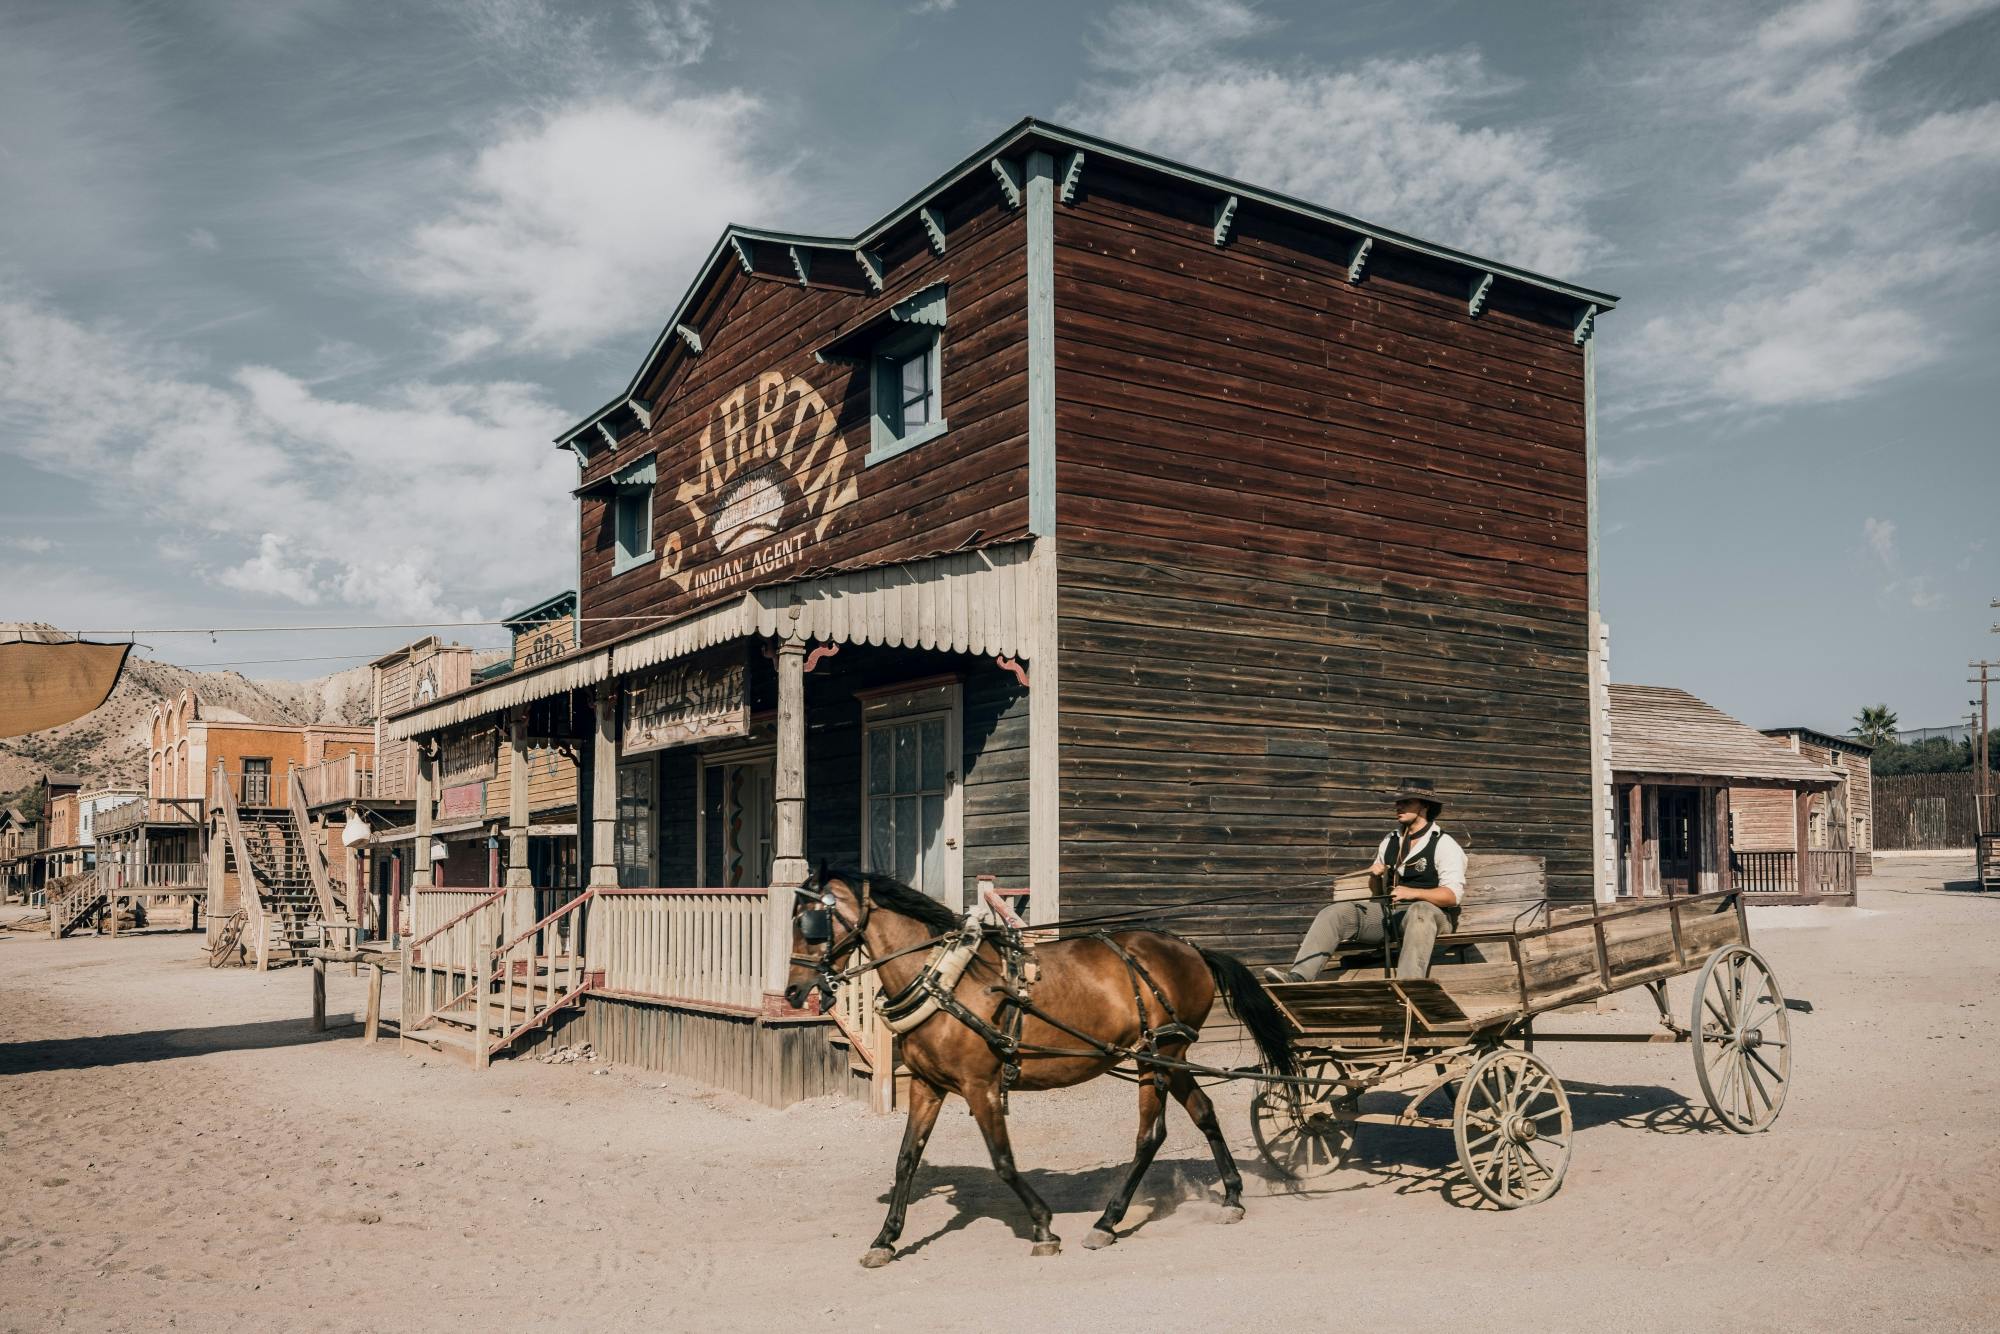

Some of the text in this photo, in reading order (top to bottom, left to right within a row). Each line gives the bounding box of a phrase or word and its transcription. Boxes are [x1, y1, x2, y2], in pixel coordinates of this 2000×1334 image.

[675, 371, 859, 542] MARTIN
[695, 532, 807, 598] INDIAN AGENT
[684, 664, 744, 719] Store
